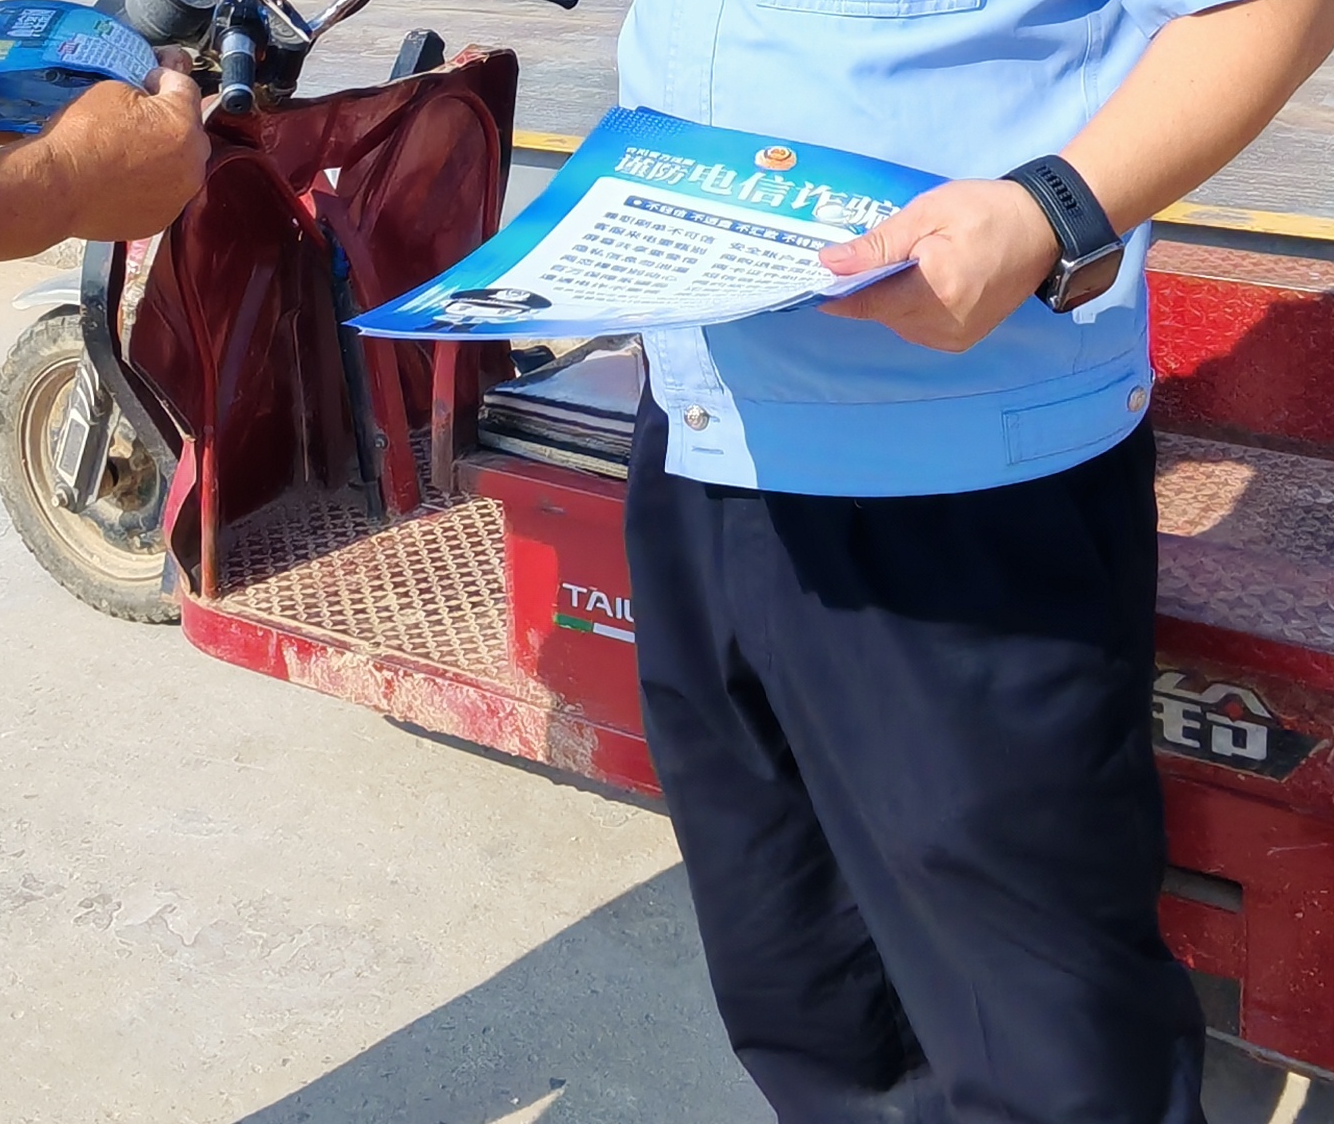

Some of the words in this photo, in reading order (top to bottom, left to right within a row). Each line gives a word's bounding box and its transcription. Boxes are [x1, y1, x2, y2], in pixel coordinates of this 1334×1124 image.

[613, 152, 902, 230] 谨防电信诈骗
